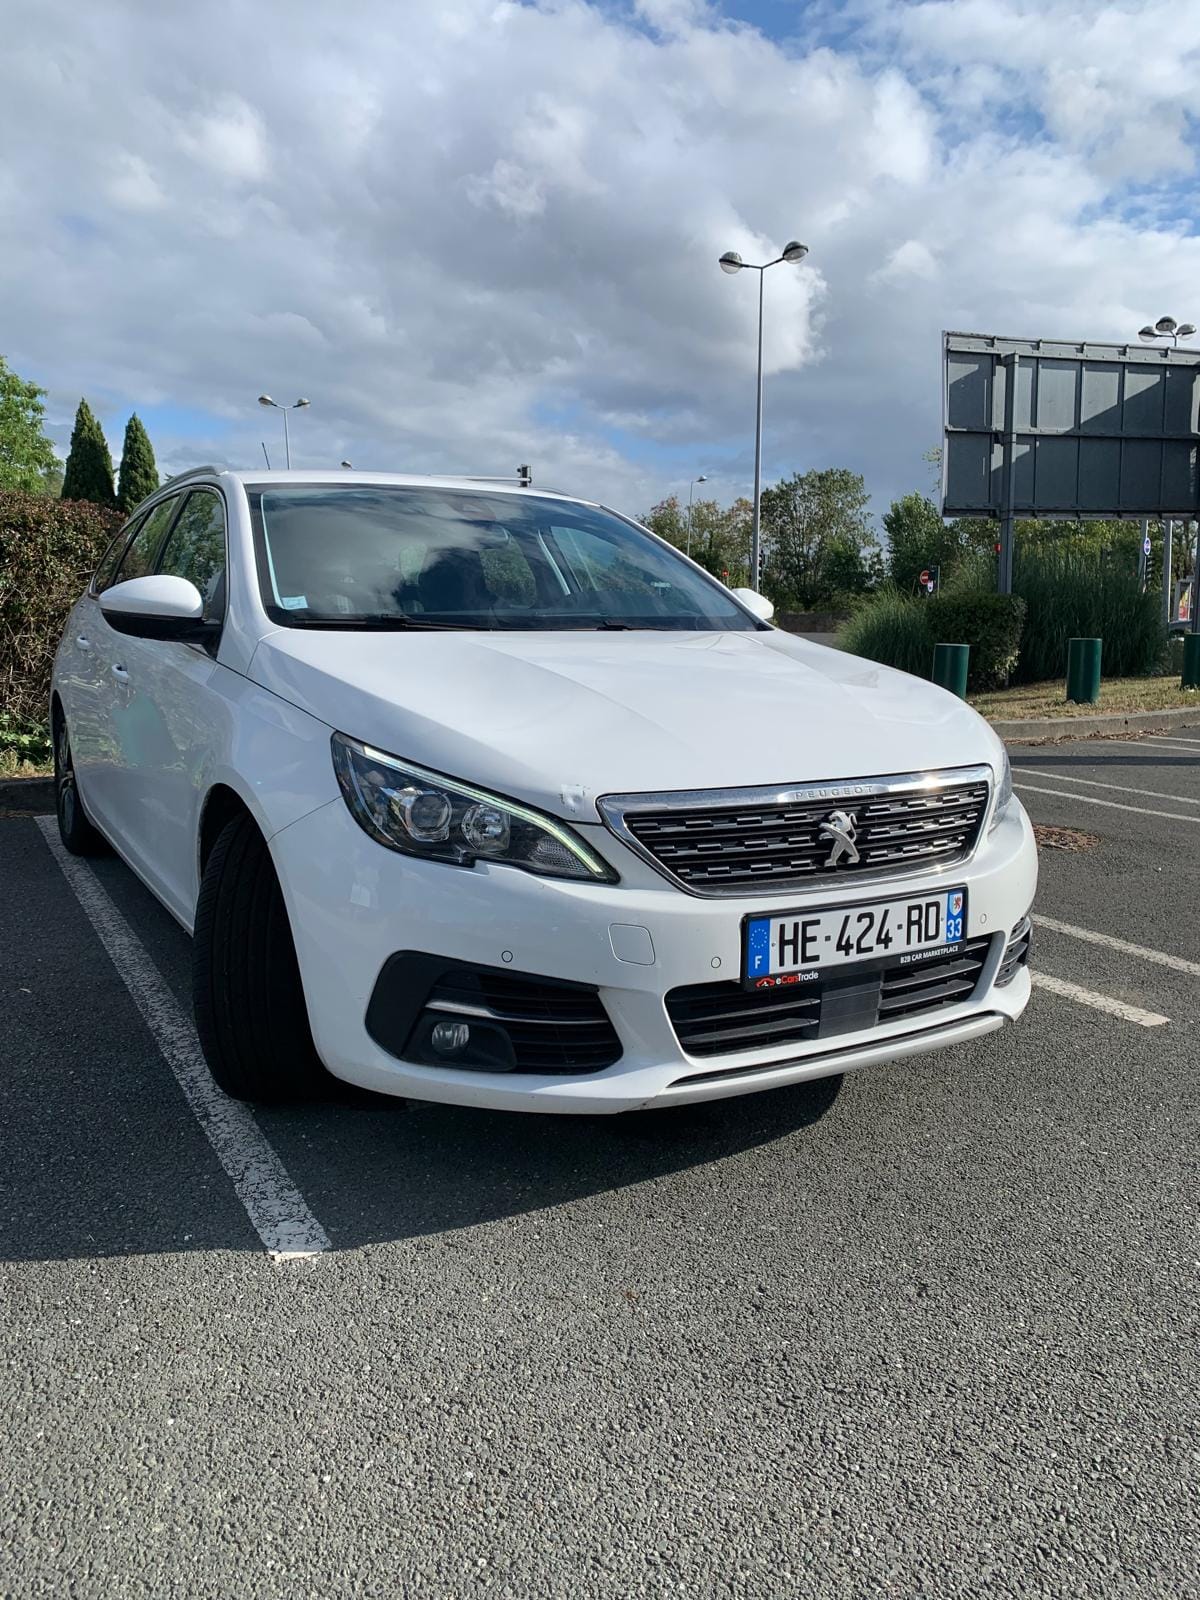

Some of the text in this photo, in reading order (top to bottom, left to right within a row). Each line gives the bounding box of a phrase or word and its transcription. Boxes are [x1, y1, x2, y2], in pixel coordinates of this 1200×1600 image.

[795, 785, 873, 800] PEUGEOT
[779, 901, 940, 967] HE-424-RD
[947, 917, 962, 938] 33
[911, 953, 923, 961] CAR
[922, 945, 959, 959] MARKETPLACE
[754, 955, 763, 969] F
[775, 971, 819, 985] eCarsTrade
